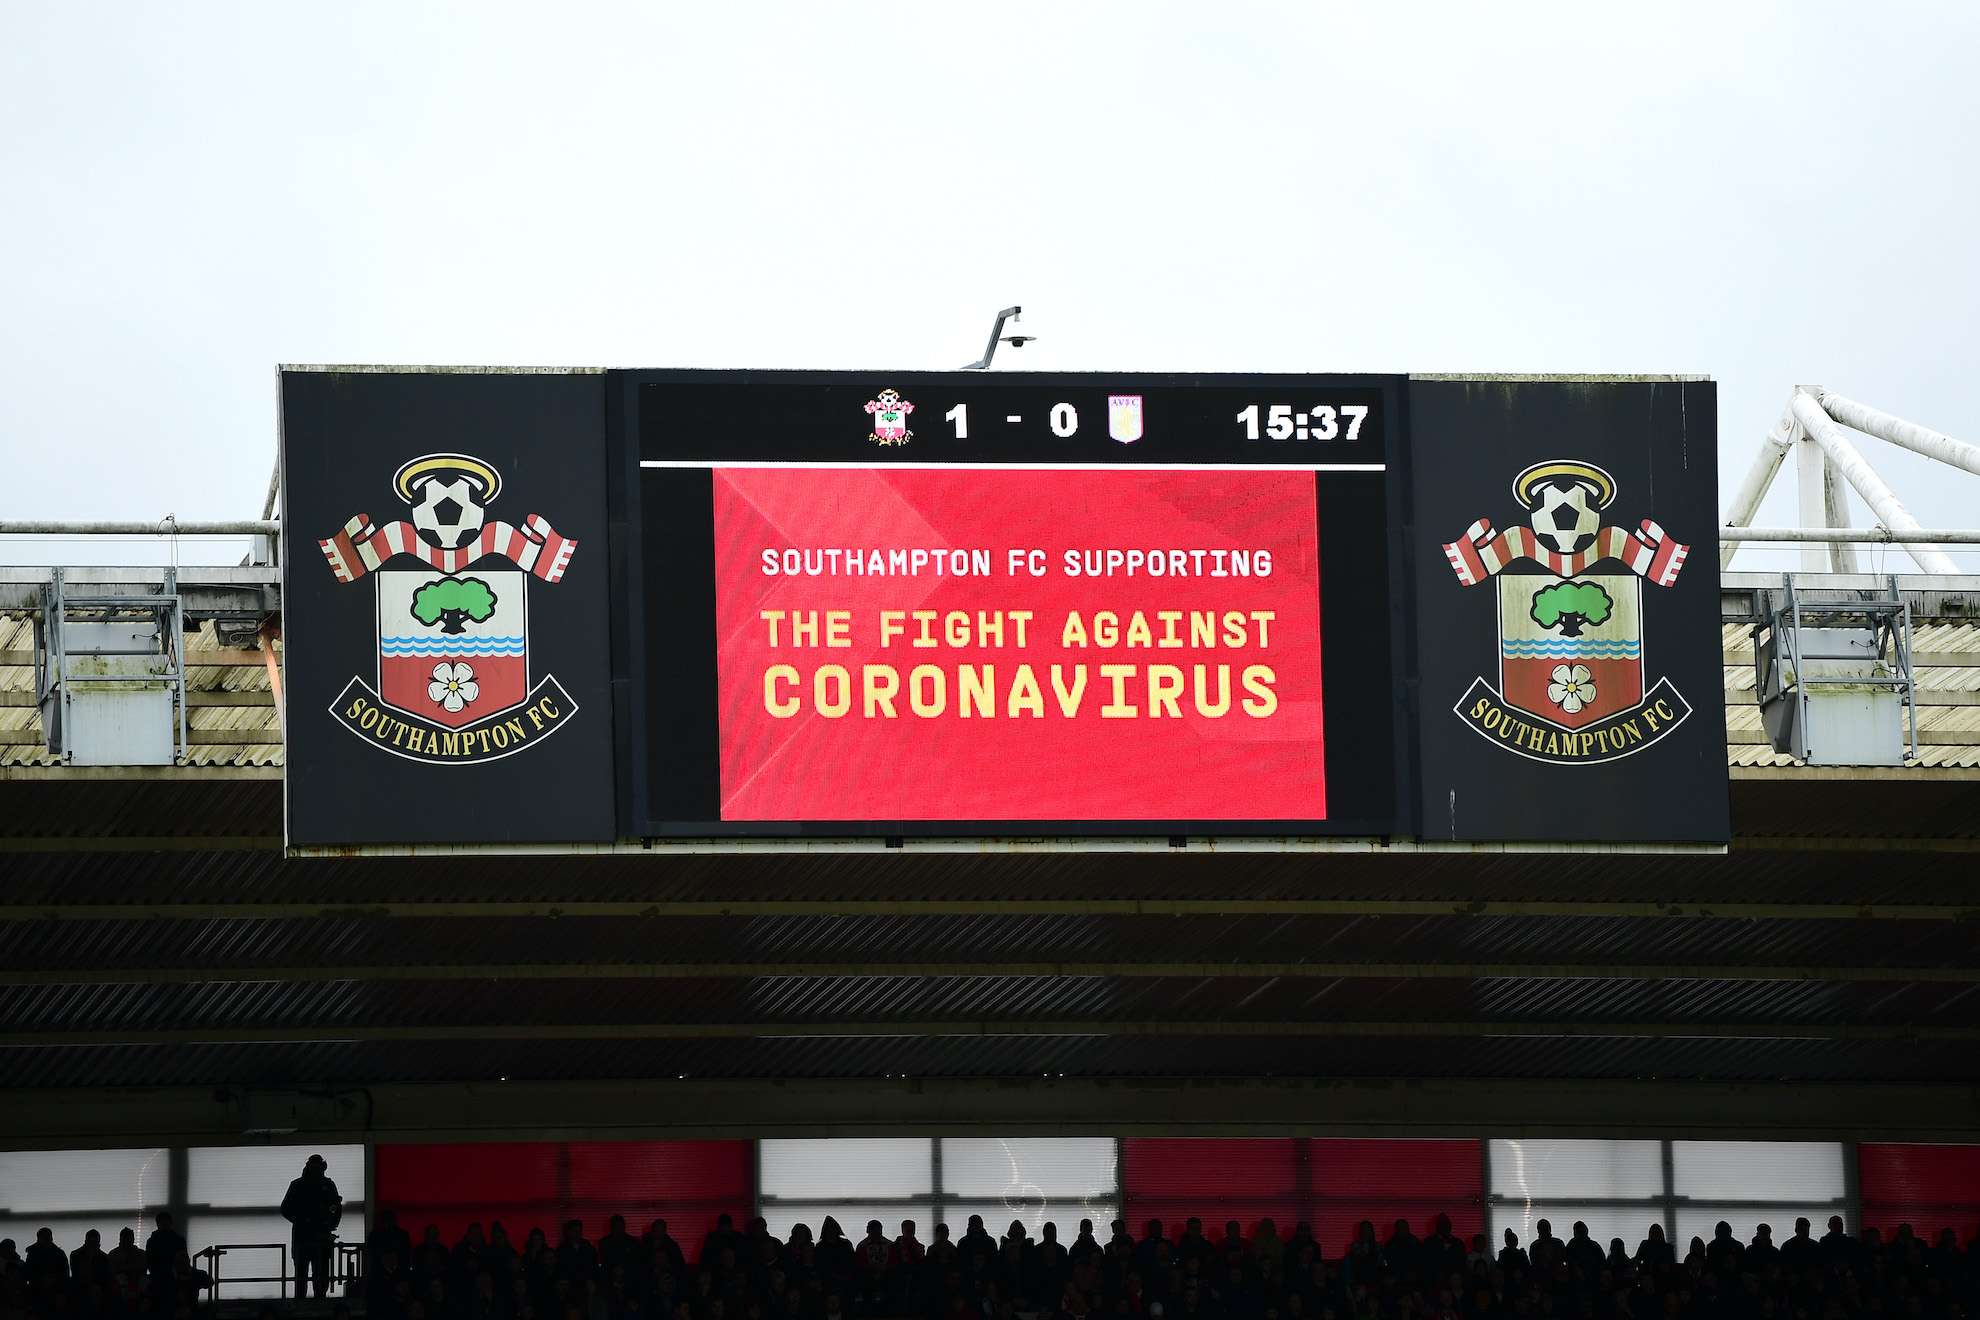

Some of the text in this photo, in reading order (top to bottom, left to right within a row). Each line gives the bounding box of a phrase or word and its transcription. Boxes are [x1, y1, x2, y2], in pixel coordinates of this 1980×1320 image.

[945, 403, 968, 439] 1
[1049, 402, 1079, 438] 0
[1236, 404, 1369, 441] 15:37
[761, 548, 1272, 577] SOUTHAMPTON FC SUPPORTING
[760, 610, 1277, 649] THE FIGHT AGAINST
[763, 664, 1279, 719] CORONAVIRUS
[345, 696, 561, 756] SOUTHAMPTON FC
[1469, 698, 1675, 757] SOUTHAMPTON FC
